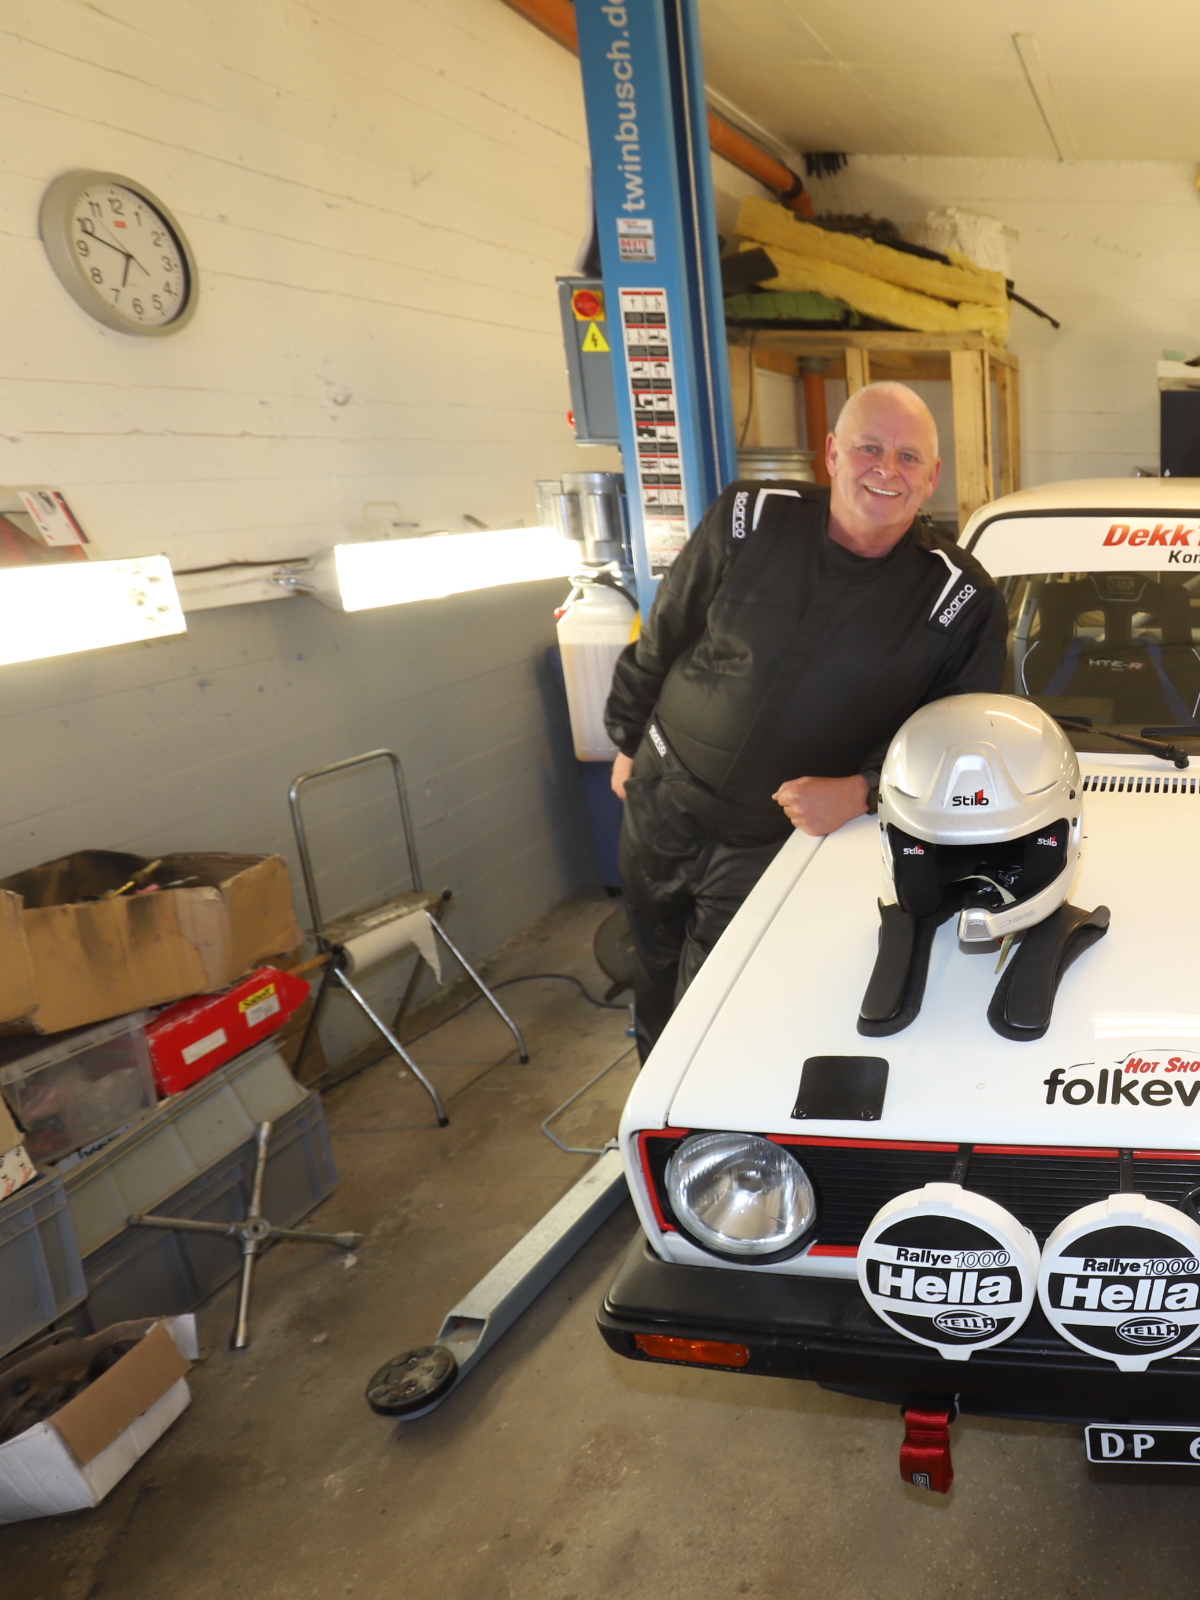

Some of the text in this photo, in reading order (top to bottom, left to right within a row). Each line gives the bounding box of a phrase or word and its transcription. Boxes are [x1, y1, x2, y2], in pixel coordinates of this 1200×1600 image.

[601, 0, 647, 212] twinbusch.d
[88, 200, 104, 218] 11
[107, 196, 125, 216] 12
[134, 210, 143, 226] 1
[150, 230, 163, 248] 2
[76, 239, 90, 258] 9
[160, 256, 174, 273] 3
[89, 266, 104, 285] 8
[110, 287, 121, 304] 7
[162, 280, 174, 295] 4
[131, 297, 145, 316] 6
[151, 293, 163, 311] 5
[733, 491, 749, 538] sparco
[1106, 579, 1135, 591] OMP
[939, 584, 976, 627] sparco
[952, 789, 989, 807] Stilo
[903, 845, 925, 855] Stilo
[1037, 836, 1058, 847] Stilo
[896, 1248, 1011, 1268] Rallye 1000
[1082, 1257, 1200, 1275] Rallye 1000
[878, 1264, 1012, 1304] Hella
[1060, 1276, 1200, 1311] Hella
[937, 1317, 996, 1329] HELLA
[1121, 1324, 1179, 1336] HELLA
[1100, 1432, 1155, 1459] DP
